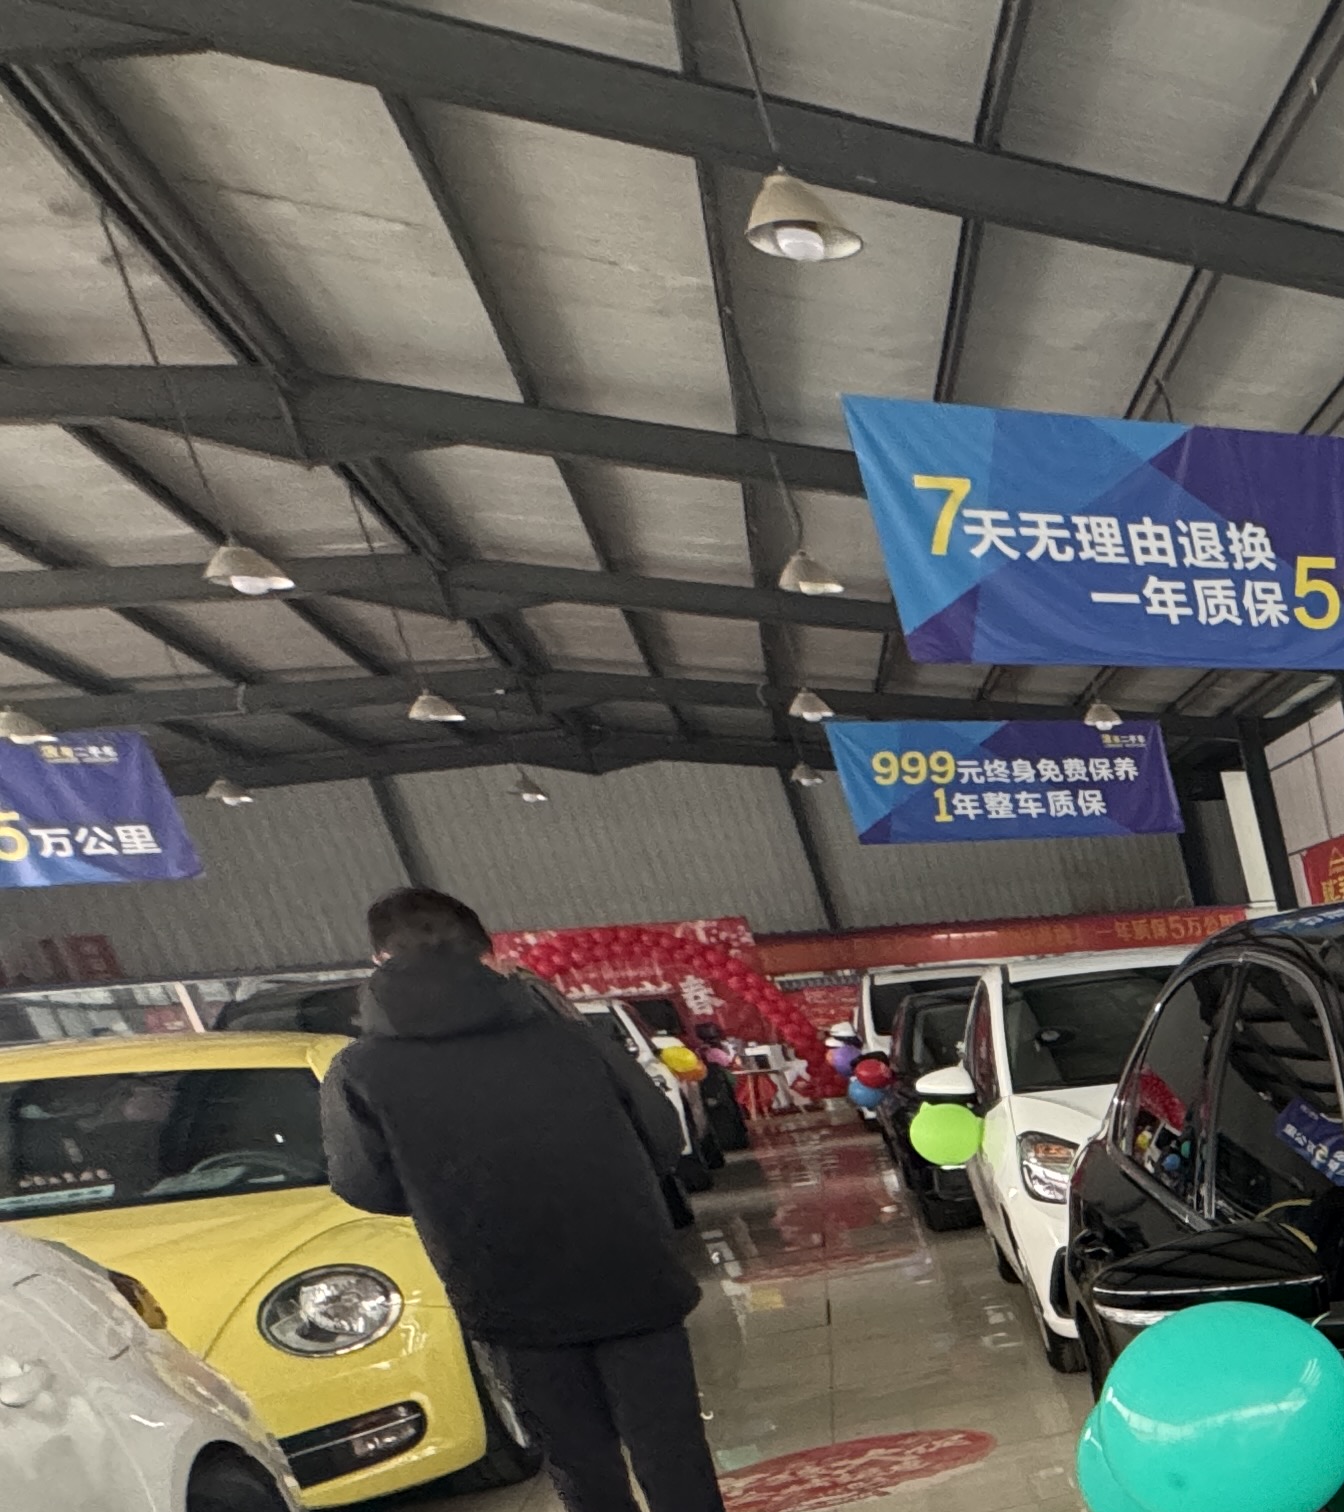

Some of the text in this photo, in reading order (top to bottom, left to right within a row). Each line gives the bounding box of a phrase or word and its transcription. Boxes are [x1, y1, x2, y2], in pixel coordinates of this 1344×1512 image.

[913, 475, 1276, 571] 7天无理由退换
[871, 750, 1139, 786] 999元终身免费保养
[933, 787, 1108, 823] 1年整车质保
